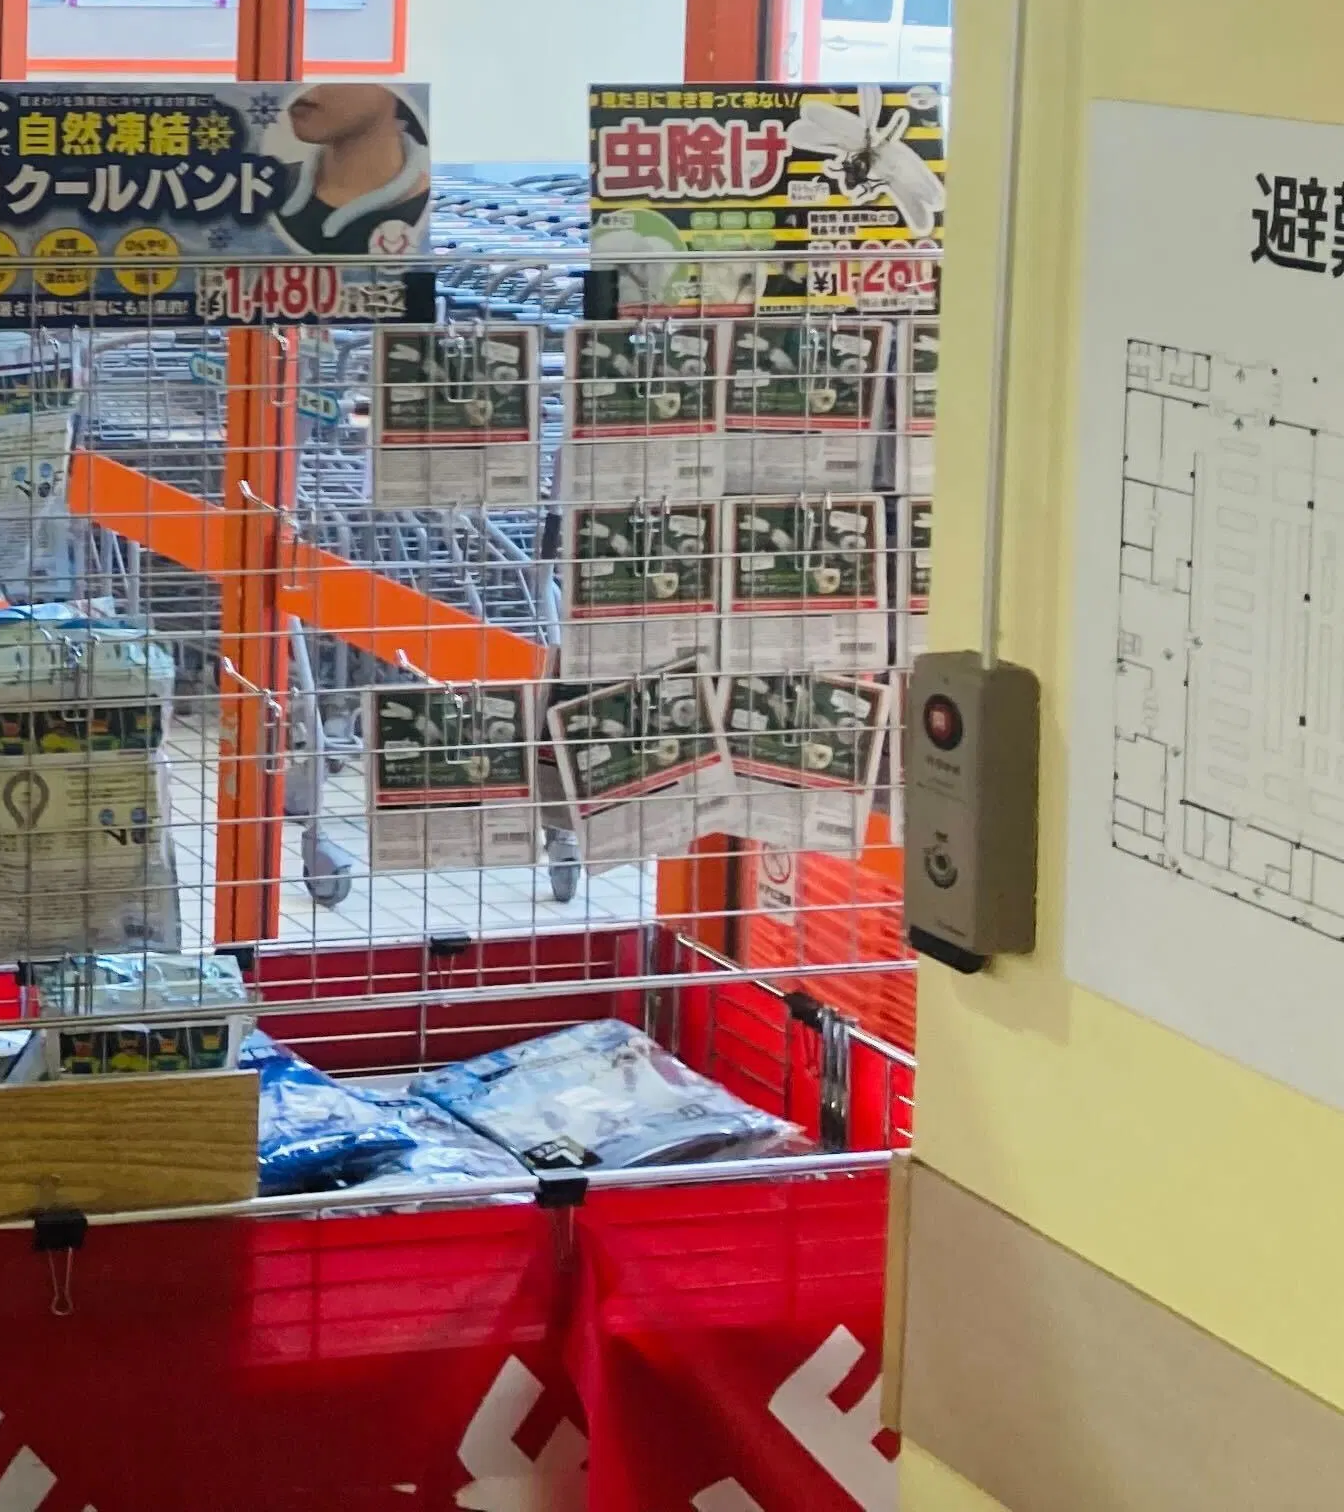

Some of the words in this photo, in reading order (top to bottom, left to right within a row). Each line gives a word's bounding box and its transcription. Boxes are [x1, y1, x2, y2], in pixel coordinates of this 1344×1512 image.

[18, 112, 191, 156] 自然凍結
[603, 123, 788, 193] 虫除け
